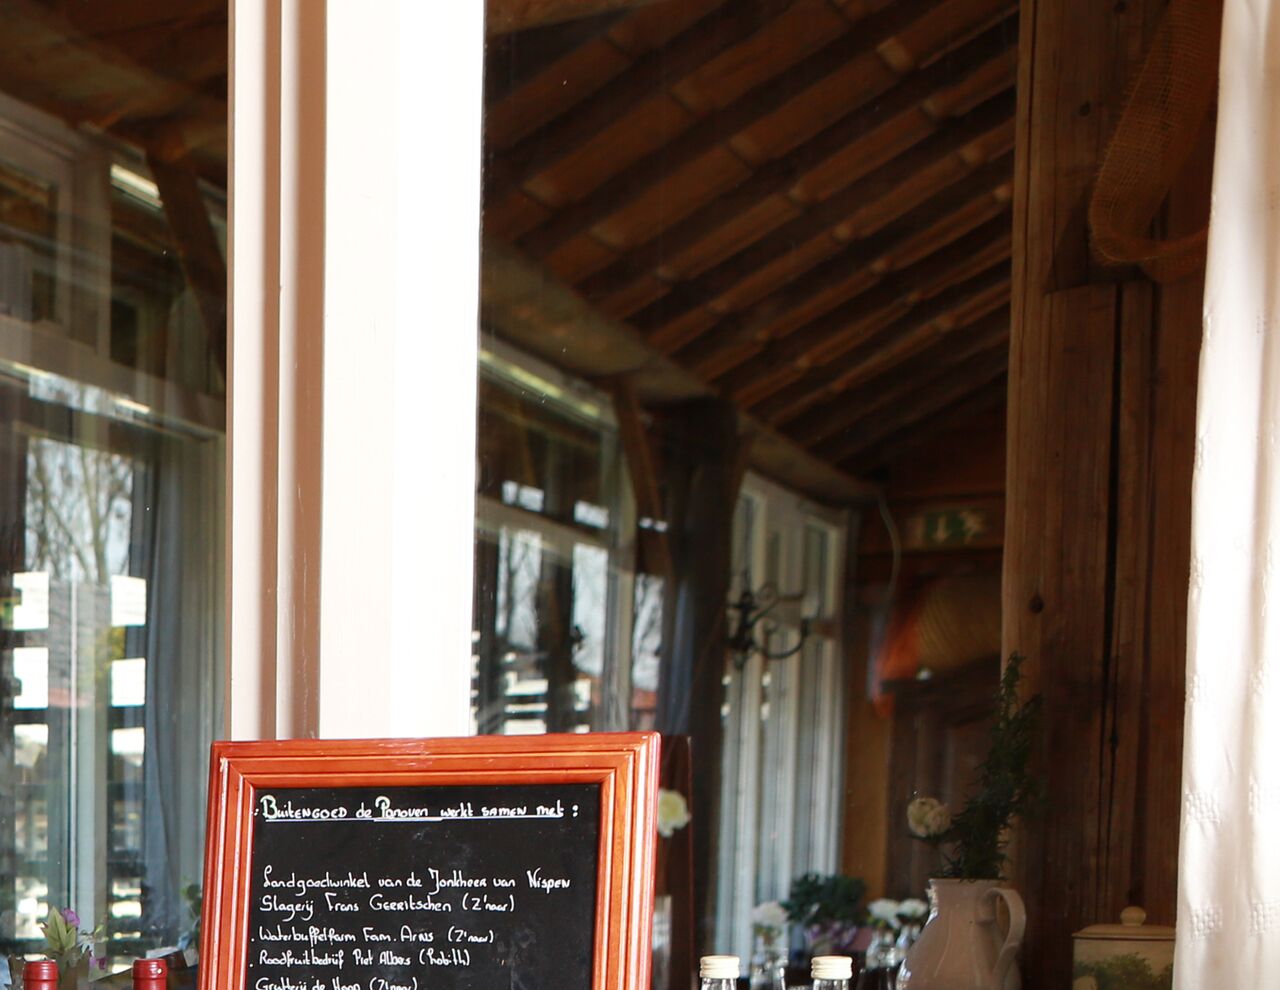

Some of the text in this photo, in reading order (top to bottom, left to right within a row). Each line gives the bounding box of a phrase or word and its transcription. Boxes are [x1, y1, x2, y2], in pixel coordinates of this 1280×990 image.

[355, 802, 373, 818] de
[374, 796, 429, 819] Panoven
[440, 802, 474, 817] werkt
[536, 799, 565, 817] met
[378, 878, 402, 888] van
[406, 872, 423, 888] de
[493, 878, 516, 888] van
[259, 894, 314, 922] Slagerij
[324, 892, 360, 912] Frans
